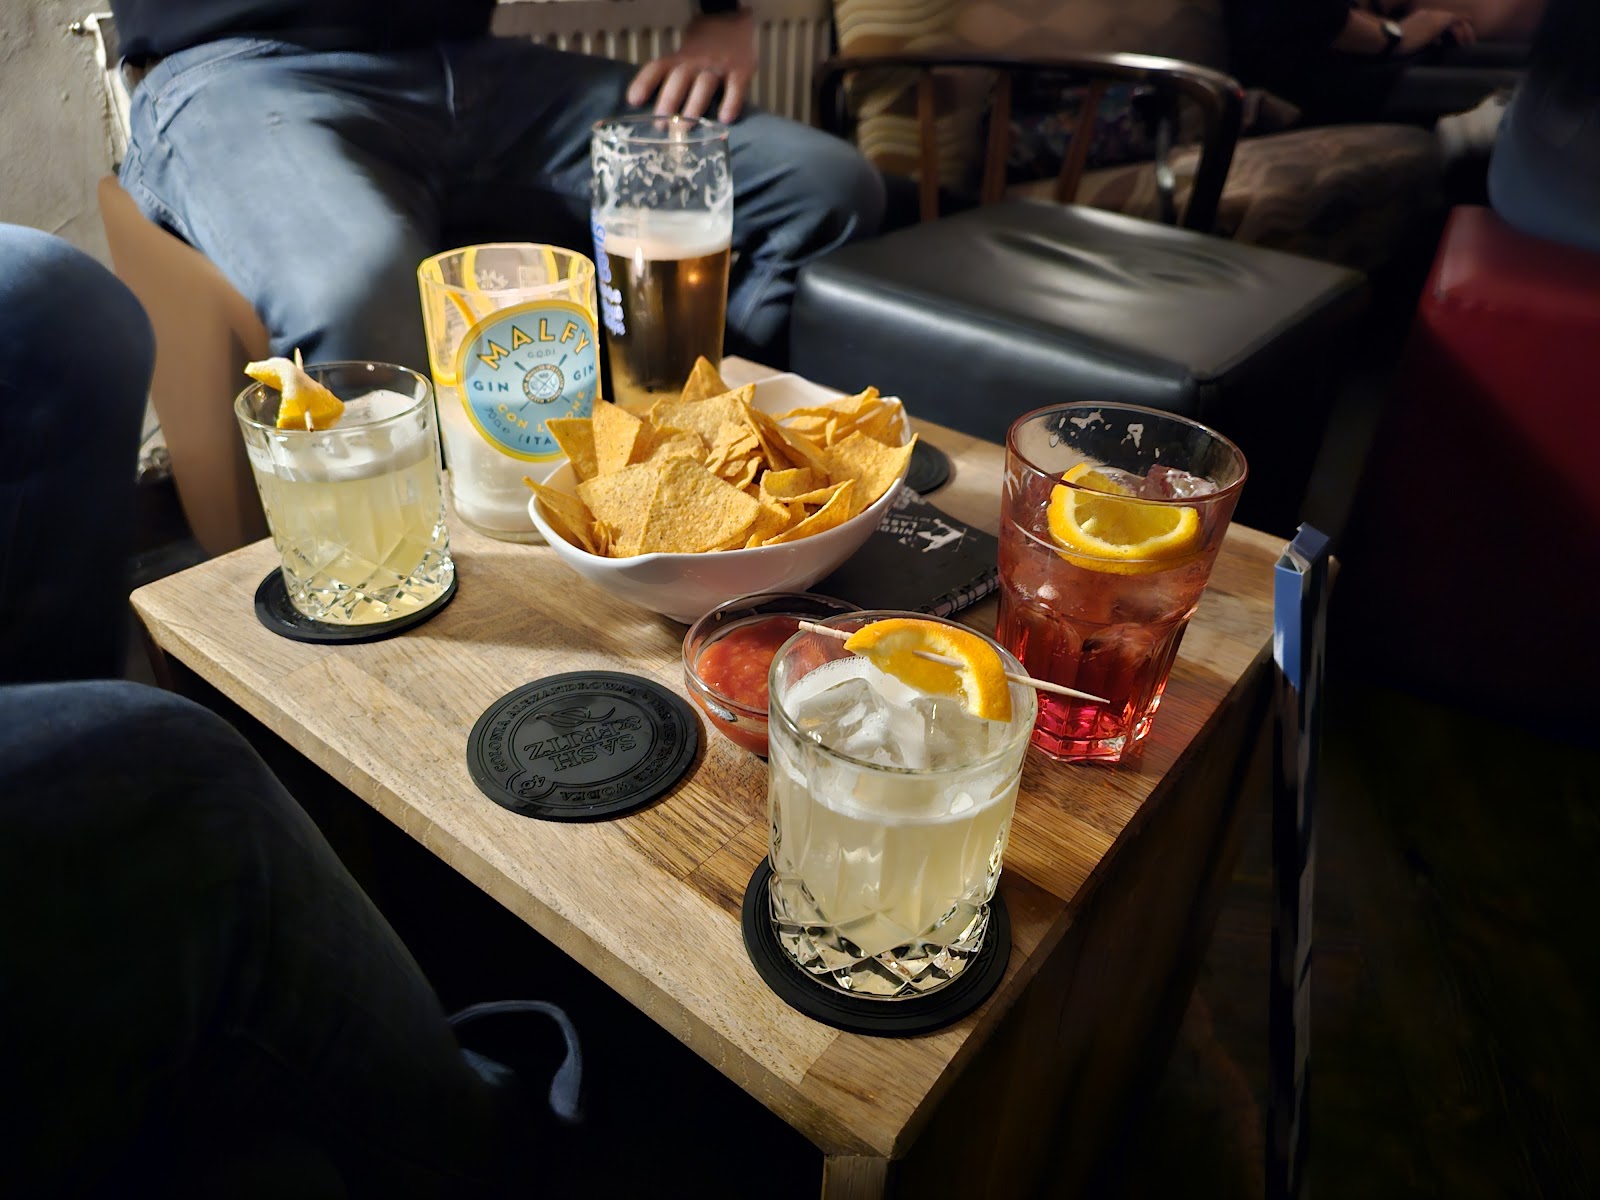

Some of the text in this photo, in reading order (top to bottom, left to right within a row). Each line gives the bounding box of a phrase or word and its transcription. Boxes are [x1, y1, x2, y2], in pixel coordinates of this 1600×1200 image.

[477, 318, 590, 371] MALFY
[473, 380, 509, 392] GIN
[573, 362, 595, 381] GIN
[497, 403, 529, 430] CON
[536, 391, 585, 434] LONE
[488, 719, 510, 774] COLONIA
[548, 734, 637, 772] SASH
[560, 781, 635, 802] WODKA
